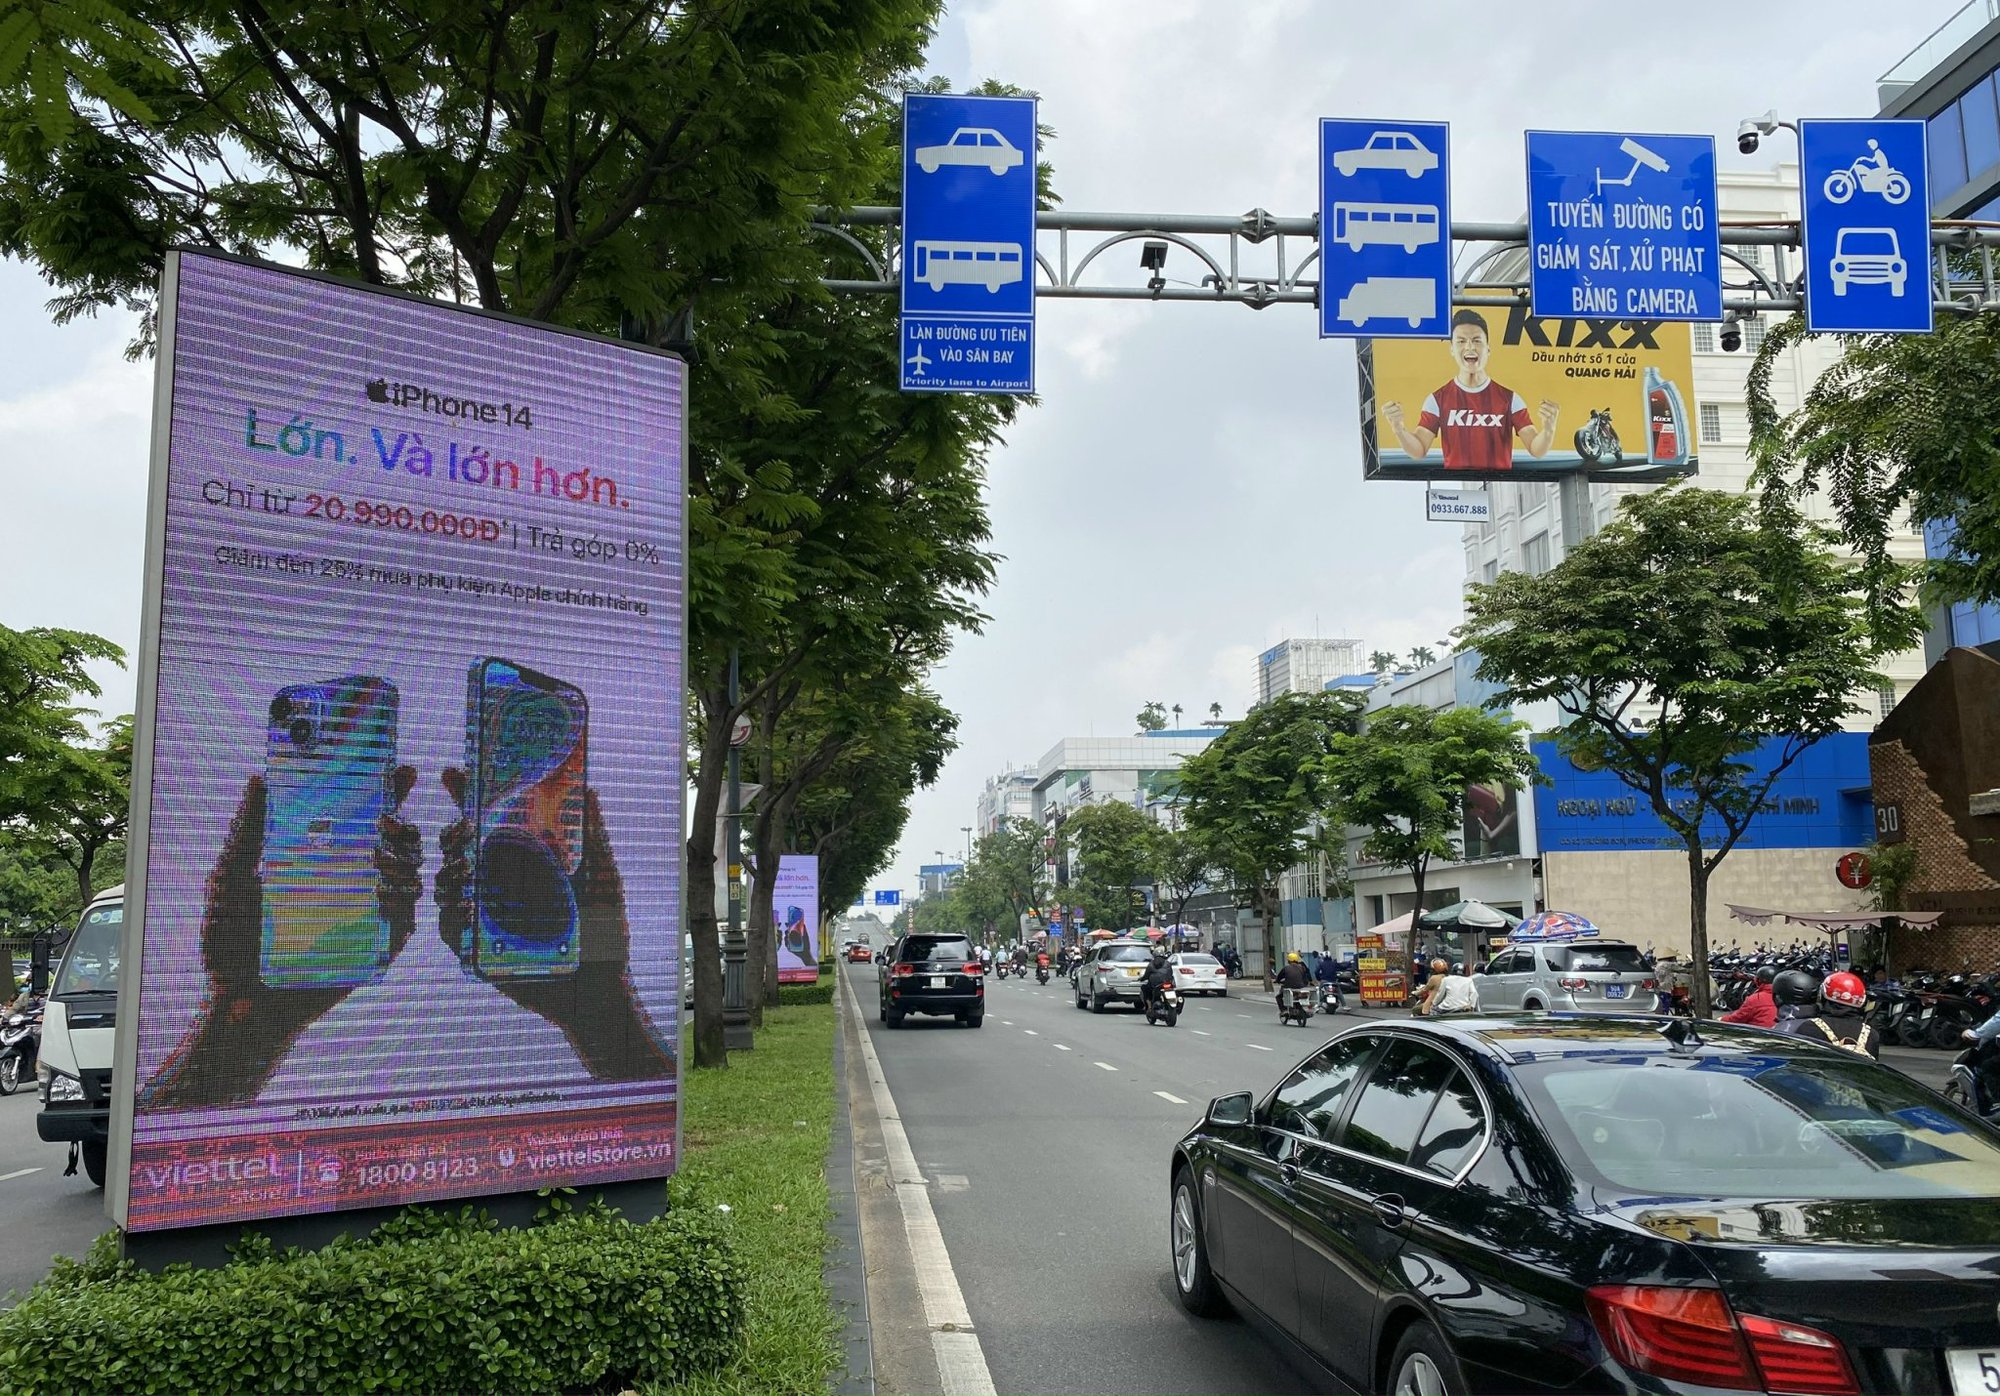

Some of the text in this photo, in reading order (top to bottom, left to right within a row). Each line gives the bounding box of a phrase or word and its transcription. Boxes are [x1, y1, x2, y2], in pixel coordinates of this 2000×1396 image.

[1548, 193, 1704, 231] TUYẾN ĐƯỜNG CÓ
[1537, 237, 1580, 270] GIÁM
[1630, 237, 1655, 271] XỬ
[1661, 246, 1705, 276] PHẠT
[1572, 275, 1699, 315] BẰNG CAMERA
[910, 323, 1027, 342] LÀN ĐƯỜNG ƯU TIÊN
[940, 345, 1014, 364] VÀO SÂN BAY
[1558, 352, 1586, 364] nhớt
[1590, 352, 1603, 364] số
[1607, 353, 1612, 364] 1
[1616, 352, 1636, 365] của
[905, 376, 1029, 389] Priority lane to Airport
[1565, 365, 1636, 379] QUANG HẢI
[1447, 409, 1504, 427] Kixx
[245, 407, 630, 510] Lớn. Và lớn hơn.
[1431, 503, 1487, 515] 0933.667.888
[527, 525, 564, 551] Trả
[571, 533, 617, 563] góp
[625, 538, 660, 565] 0%
[320, 557, 365, 581] 25%
[500, 580, 550, 604] Apple
[1877, 806, 1899, 833] 30
[145, 1152, 282, 1188] viettel
[526, 1142, 672, 1170] viettelstore.vn
[358, 1157, 478, 1186] 1800 8123
